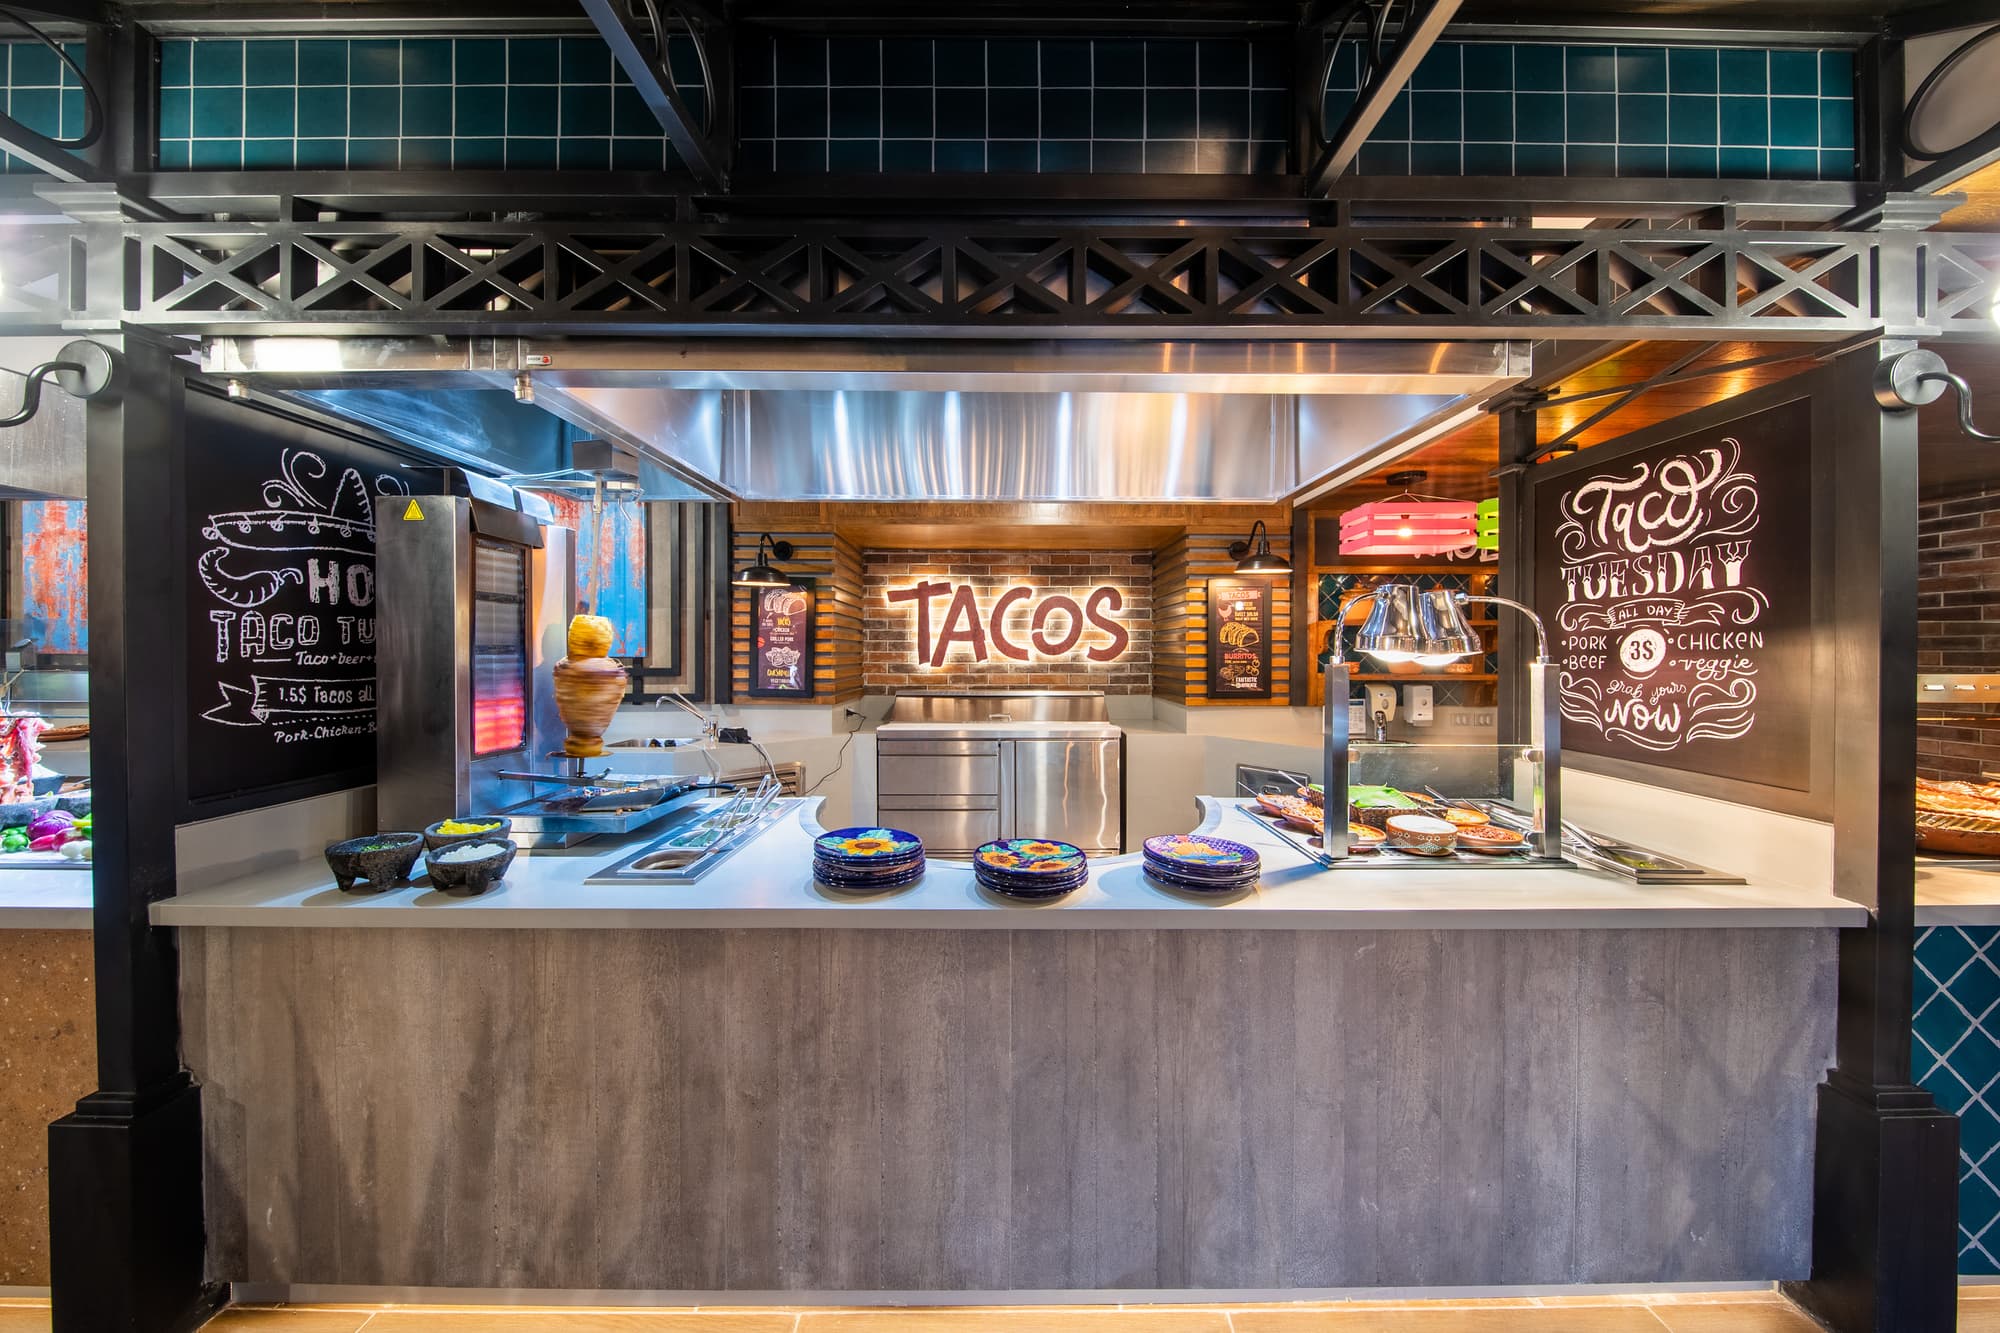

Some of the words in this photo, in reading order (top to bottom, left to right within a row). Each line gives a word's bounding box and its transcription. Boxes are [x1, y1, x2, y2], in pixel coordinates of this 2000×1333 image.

[1573, 449, 1721, 553] Taco
[1560, 540, 1752, 601] TUESDAY
[887, 581, 1129, 667] TACOS
[1618, 607, 1639, 621] ALL
[1647, 605, 1674, 617] DAY
[210, 609, 320, 663] TACO
[1569, 635, 1607, 651] PORK
[279, 685, 307, 704] 1.5$
[314, 686, 353, 703] Tacos
[1606, 680, 1643, 698] grab
[1649, 682, 1687, 705] yours
[1604, 699, 1681, 733] NOW
